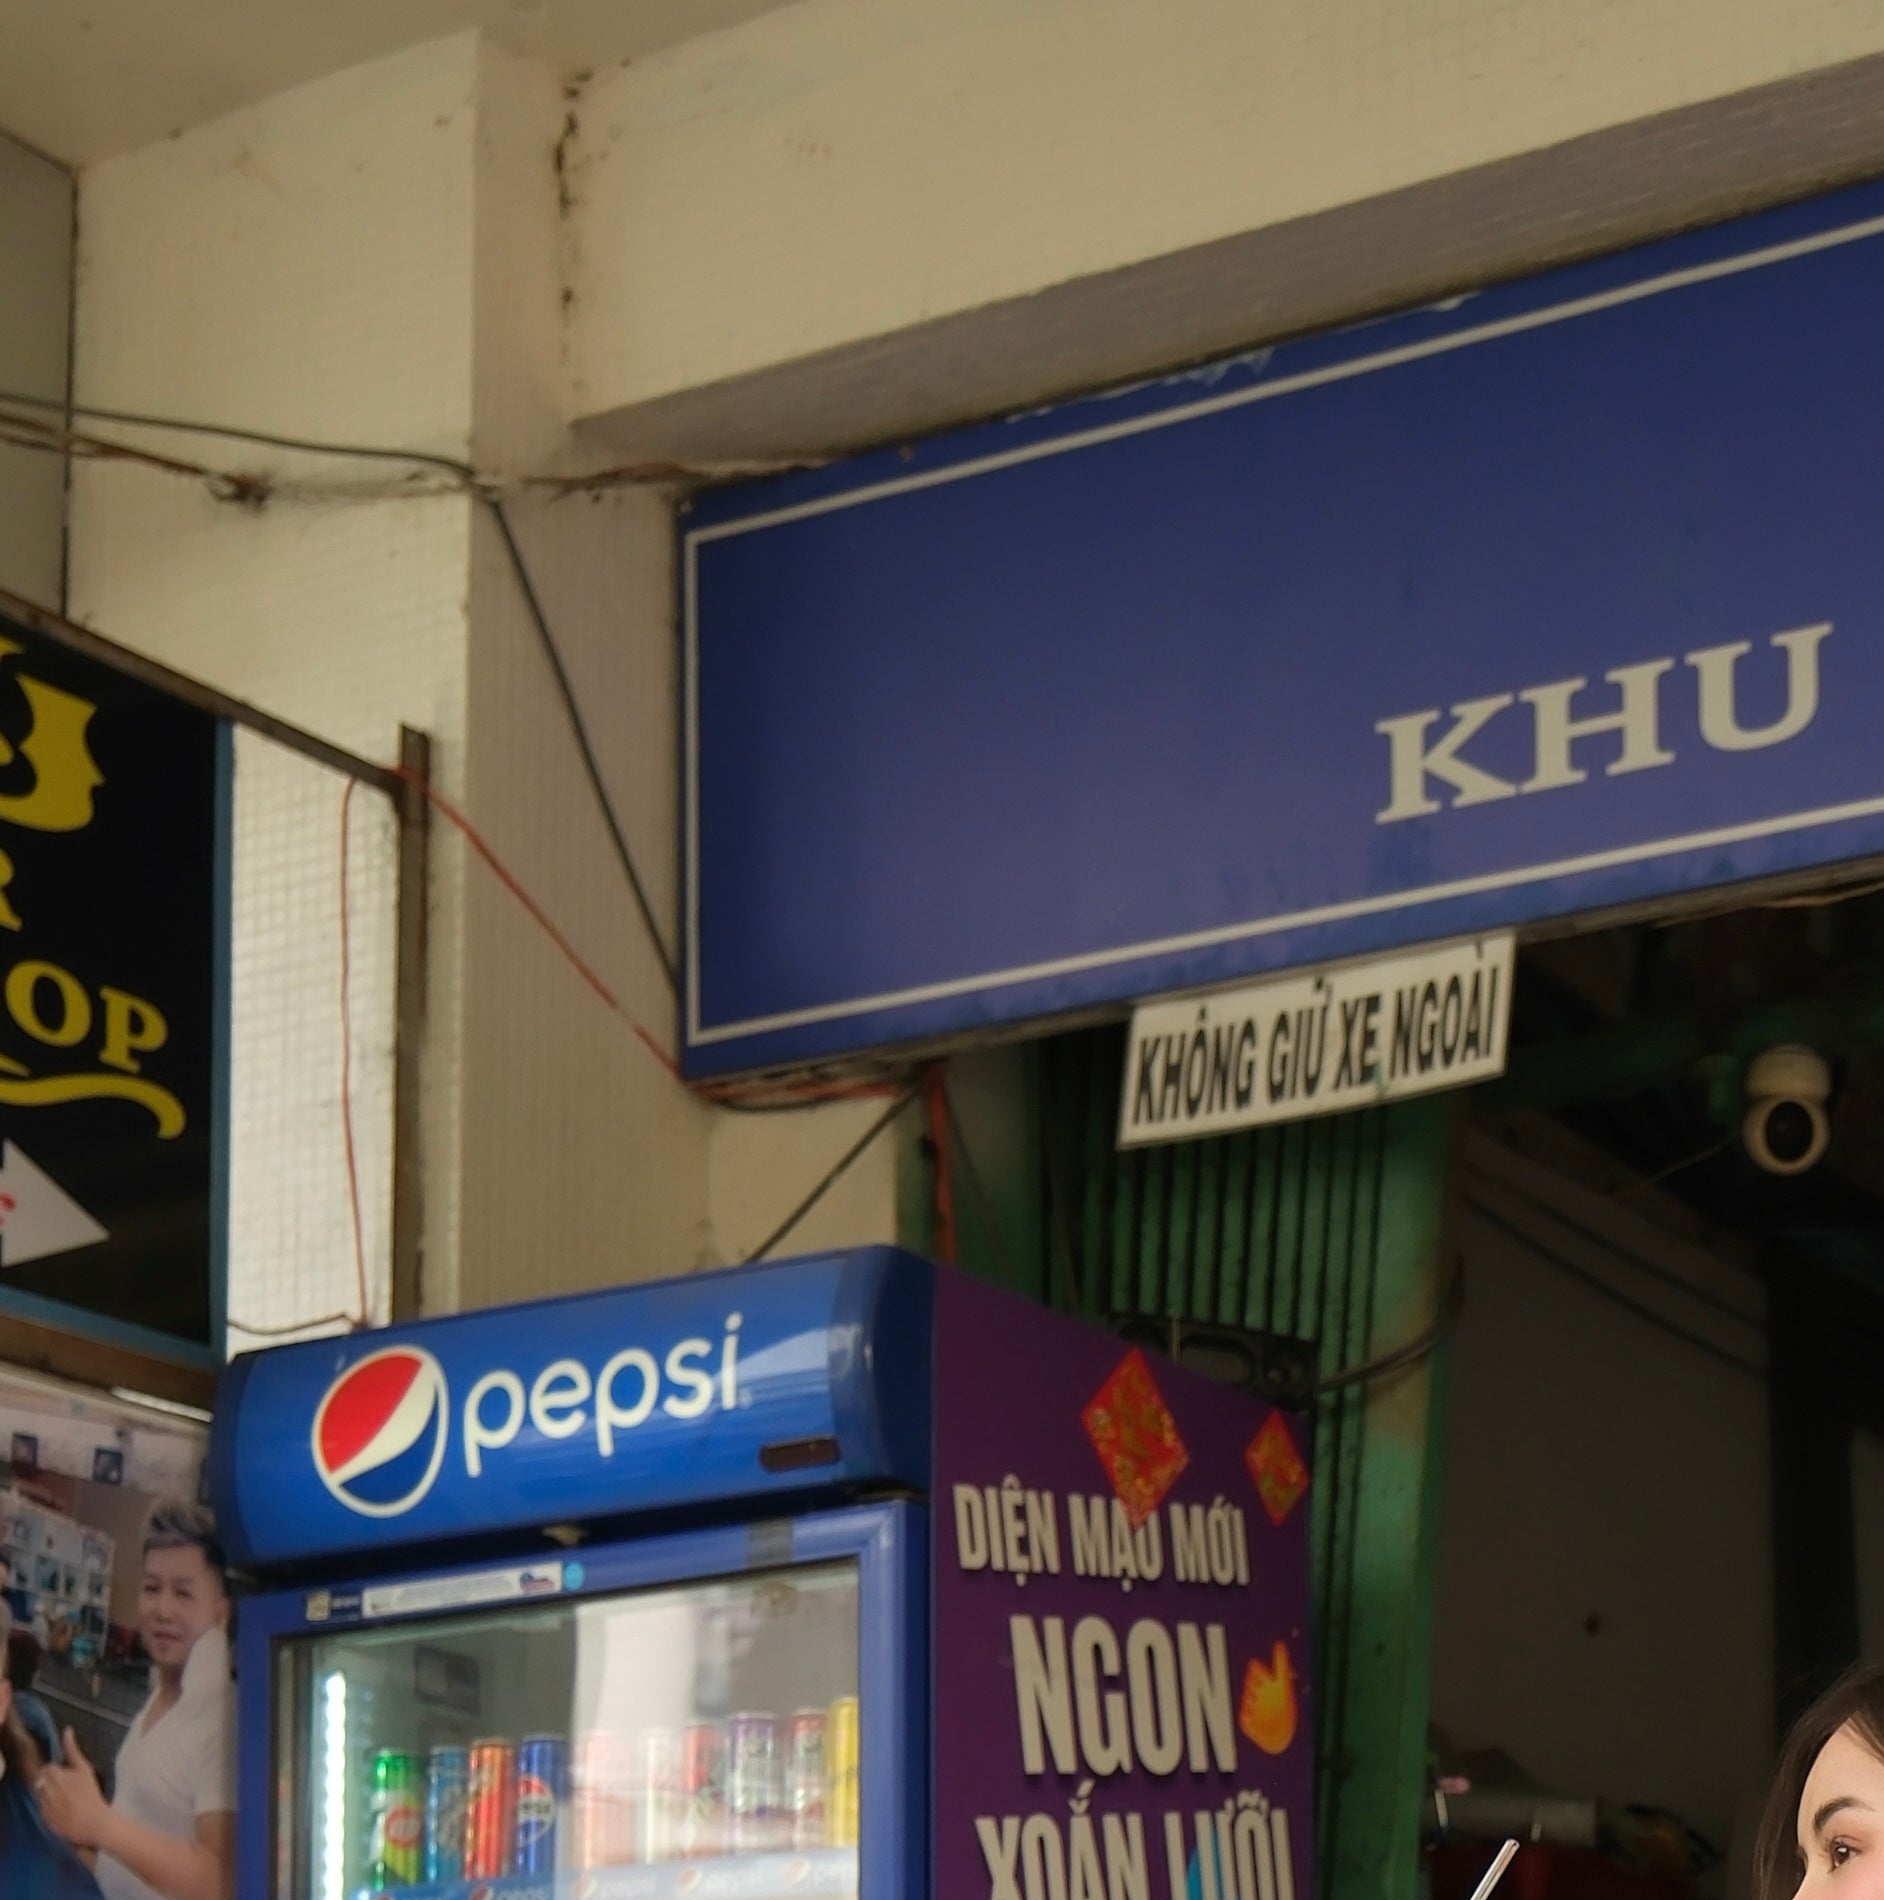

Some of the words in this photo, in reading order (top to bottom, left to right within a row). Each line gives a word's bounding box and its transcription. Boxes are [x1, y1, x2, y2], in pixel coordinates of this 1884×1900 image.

[1376, 622, 1834, 826] KHU
[1131, 1006, 1257, 1127] KHÔNG
[1266, 976, 1333, 1107] GIỮ
[1333, 993, 1382, 1092] XE
[1389, 940, 1499, 1081] NGOÀI
[463, 1312, 744, 1478] pepsi
[953, 1474, 1061, 1587] DIỆN
[1170, 1494, 1251, 1587] MỚI
[1009, 1613, 1239, 1777] NGON
